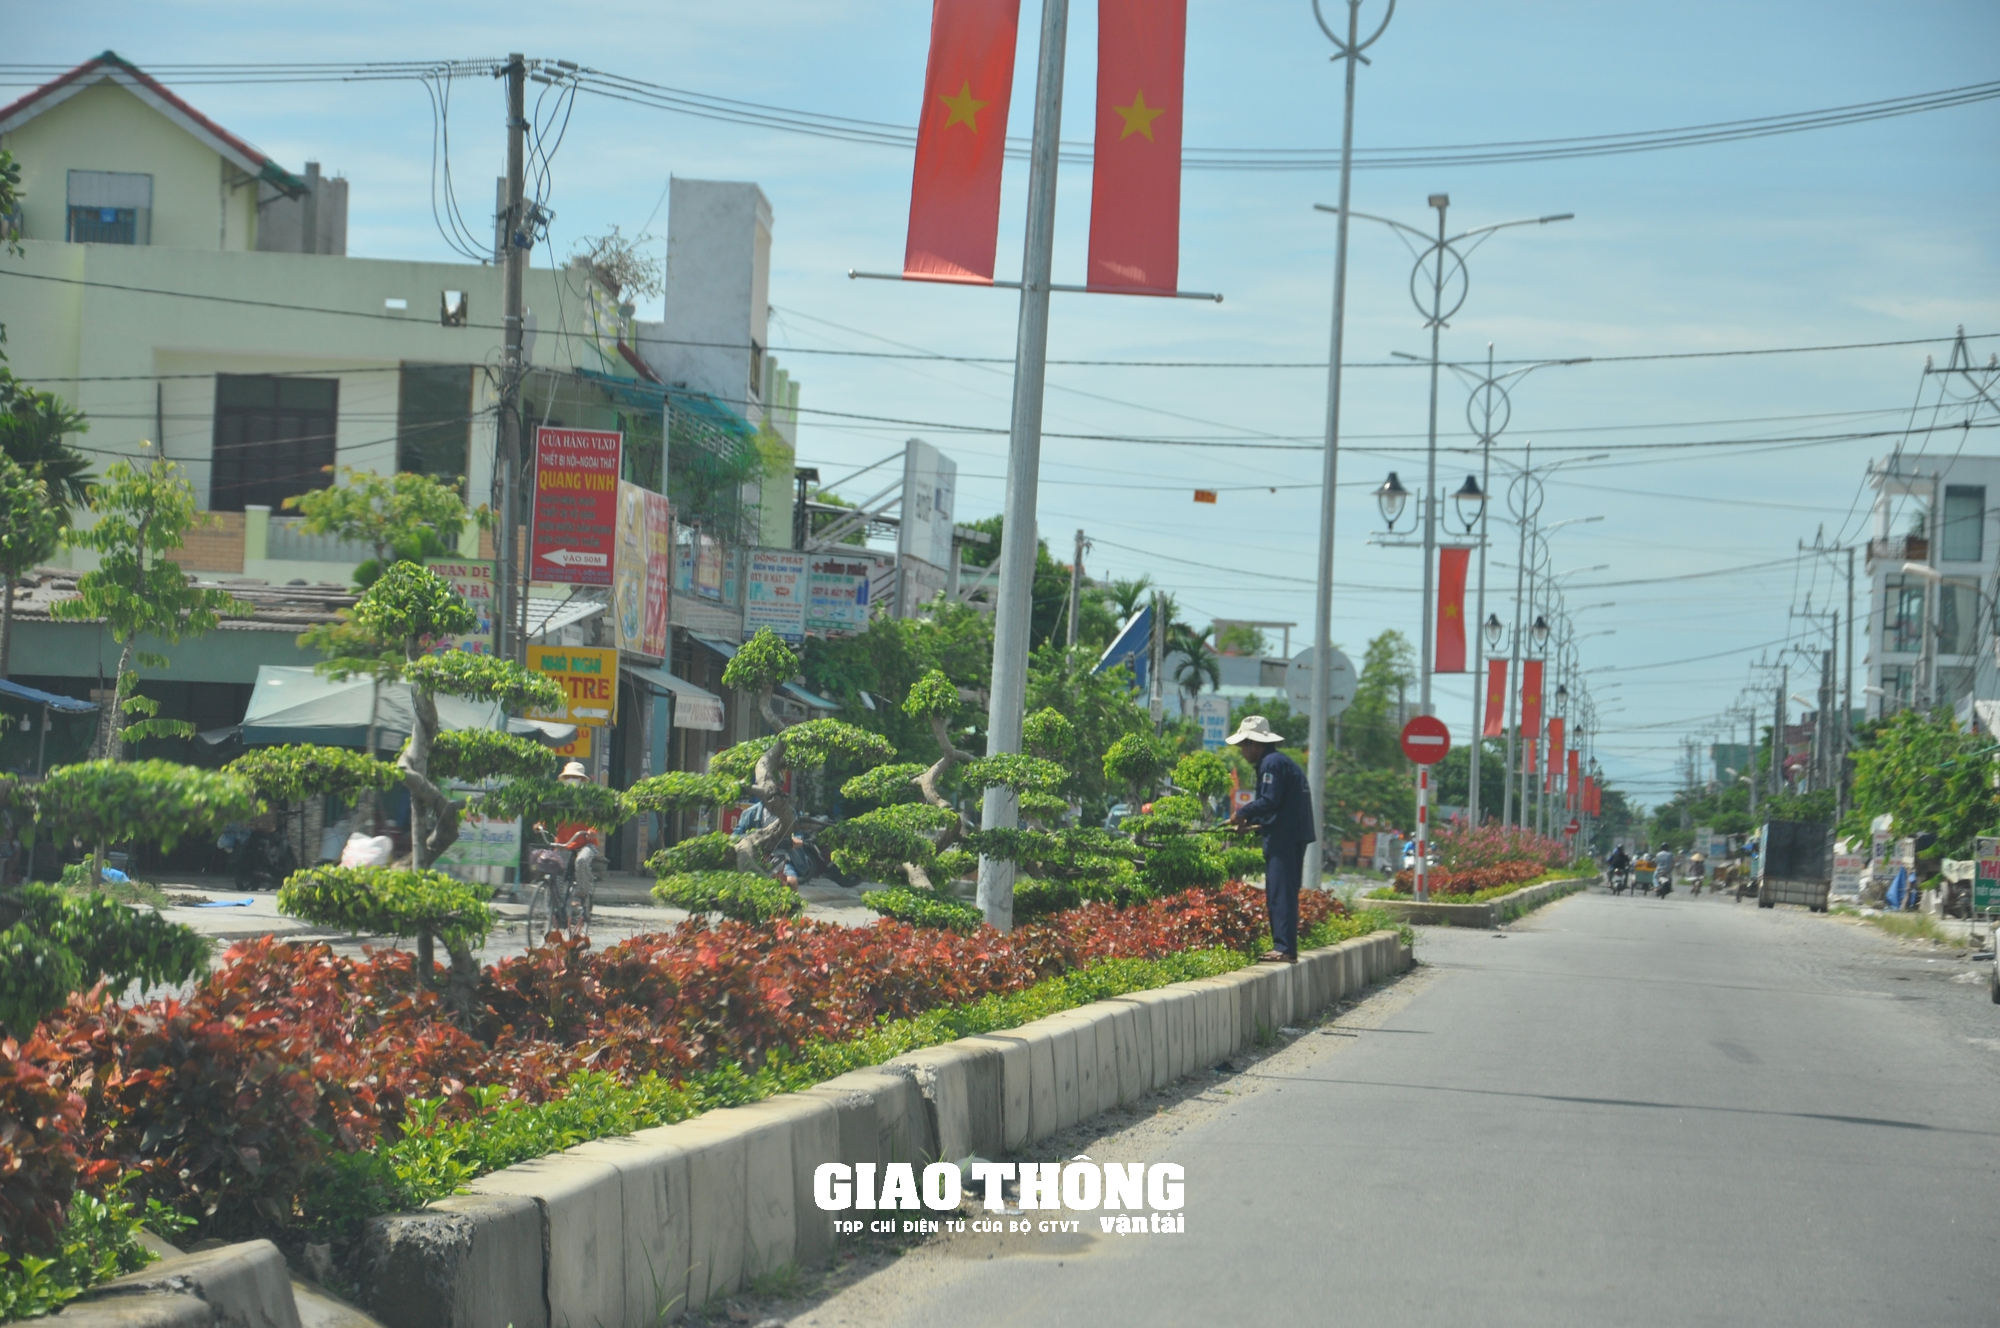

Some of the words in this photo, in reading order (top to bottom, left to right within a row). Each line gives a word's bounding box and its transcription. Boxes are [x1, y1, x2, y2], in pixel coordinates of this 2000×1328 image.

[541, 430, 561, 447] CỬA
[563, 433, 589, 449] HÀNG
[591, 437, 616, 450] VLXD
[540, 470, 581, 491] QUANG
[584, 473, 615, 492] VINH
[563, 553, 582, 562] VÀO
[541, 652, 568, 672] NHÀ
[571, 653, 602, 674] NGHỈ
[568, 676, 610, 700] TRE
